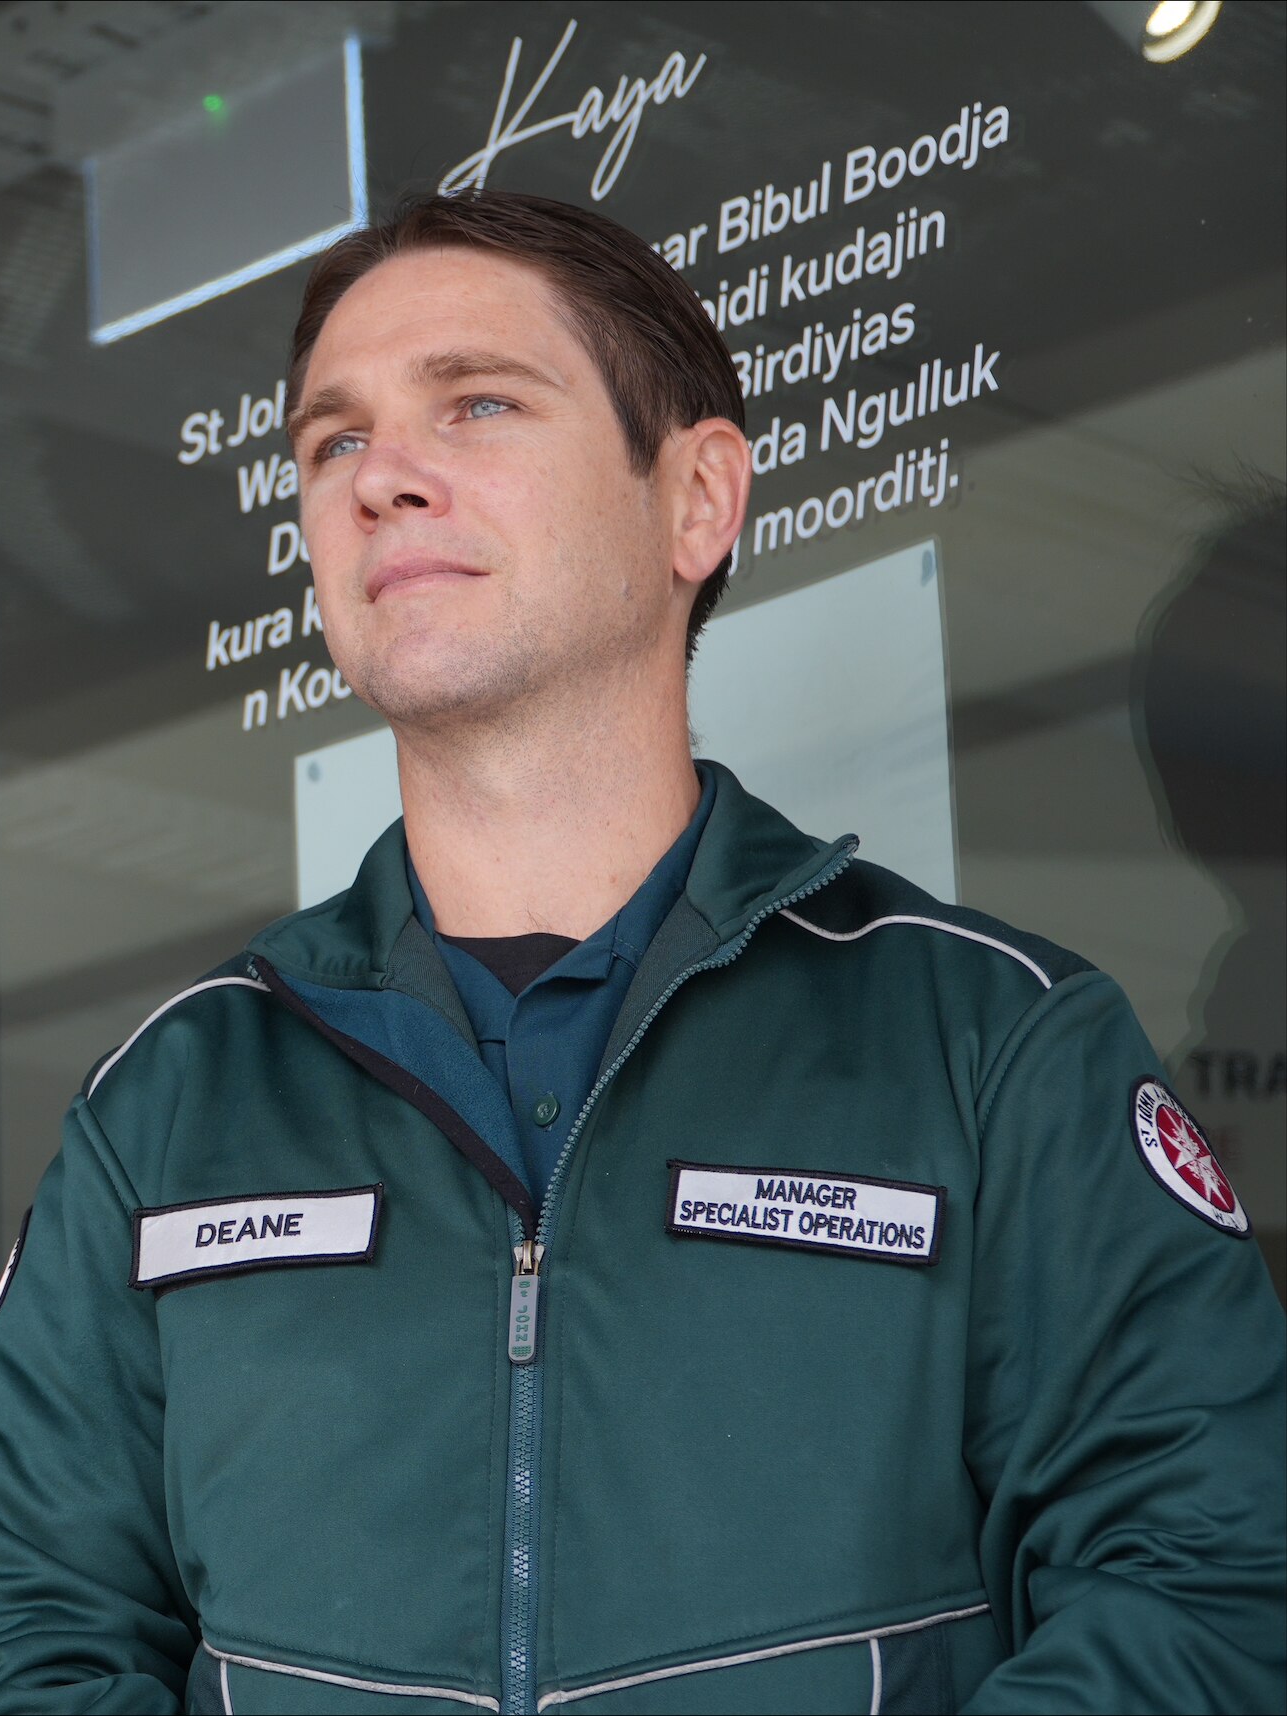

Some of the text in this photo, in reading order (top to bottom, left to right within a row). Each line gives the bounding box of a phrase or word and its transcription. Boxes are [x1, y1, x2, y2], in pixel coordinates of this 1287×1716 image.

[437, 18, 707, 201] Kaya
[178, 408, 224, 465] St
[650, 223, 708, 271] ar
[718, 161, 832, 254] Bibul
[844, 101, 1010, 205] Boodja
[780, 206, 946, 308] kudajin
[206, 607, 294, 671] kura
[747, 416, 807, 475] da
[820, 343, 1001, 452] Ngulluk
[243, 689, 269, 732] n
[753, 437, 959, 555] moorditj.
[195, 1212, 304, 1248] DEANE
[679, 1200, 926, 1250] SPECIALIST OPERATIONS
[754, 1178, 857, 1211] MANAGER
